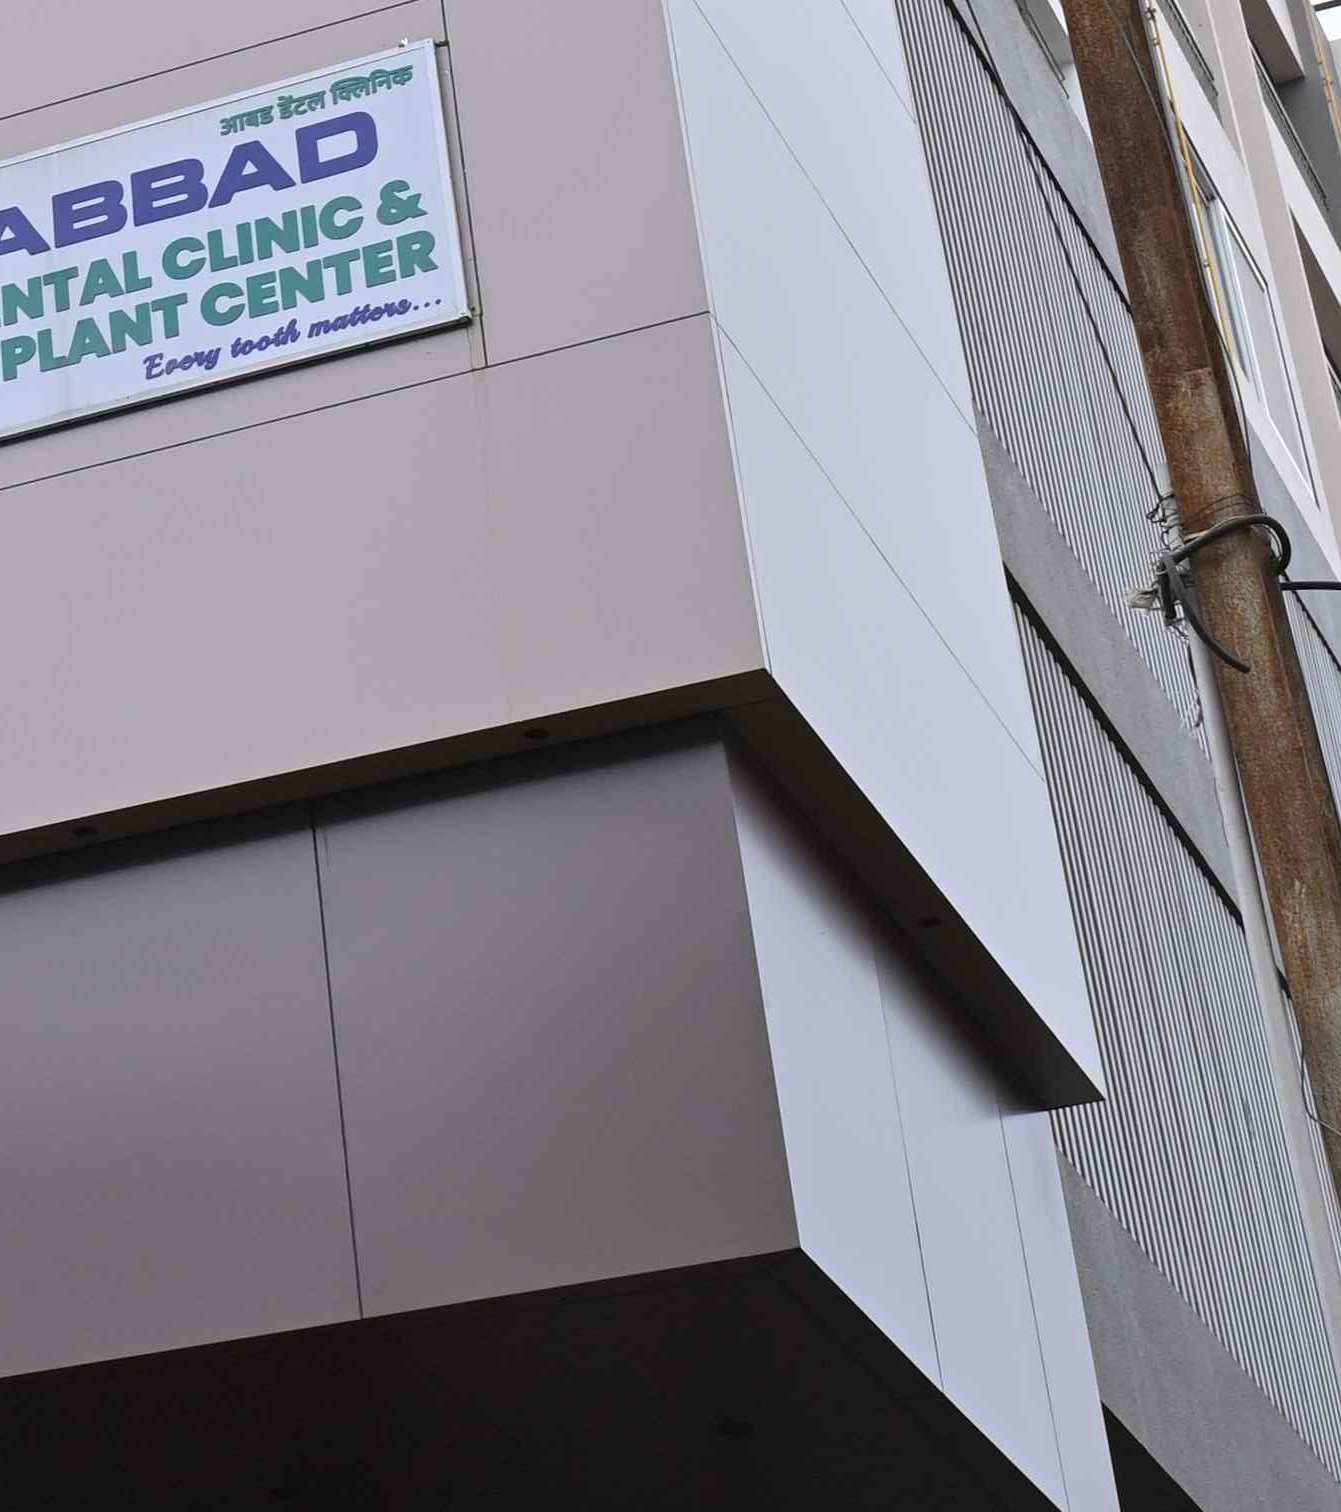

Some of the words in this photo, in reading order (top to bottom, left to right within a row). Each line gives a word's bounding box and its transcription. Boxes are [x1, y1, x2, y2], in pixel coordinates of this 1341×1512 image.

[276, 89, 326, 121] डेंटल
[330, 64, 414, 105] क्लिनिक
[161, 193, 365, 282] CLINIC
[376, 179, 428, 225] &
[200, 230, 438, 326] CENTER
[143, 345, 222, 380] Every
[230, 318, 300, 359] tooth
